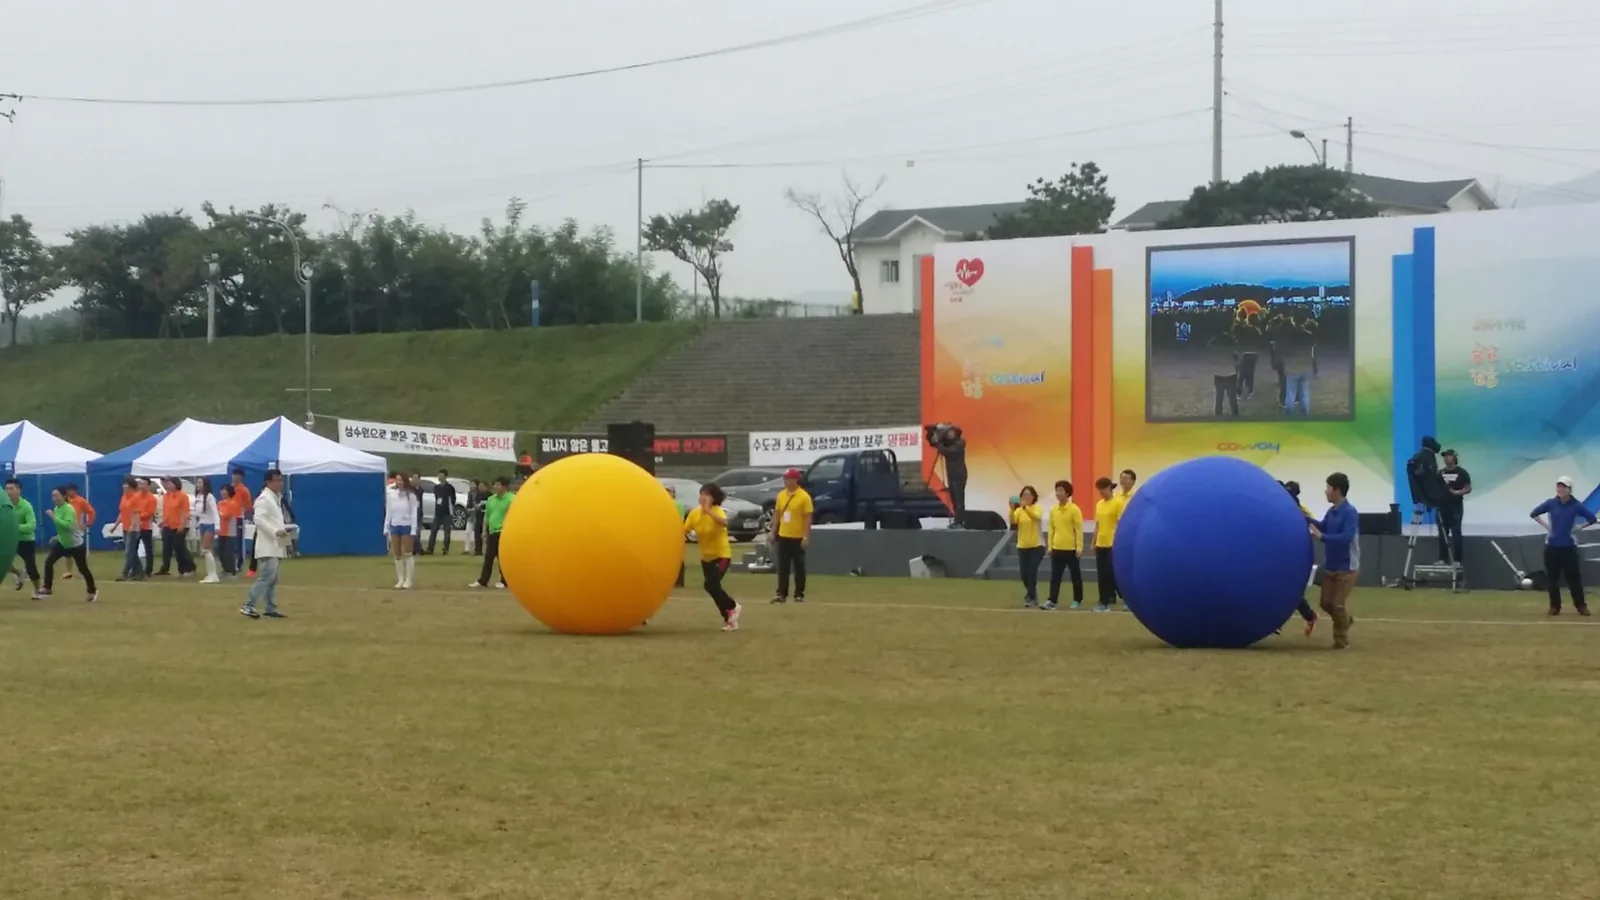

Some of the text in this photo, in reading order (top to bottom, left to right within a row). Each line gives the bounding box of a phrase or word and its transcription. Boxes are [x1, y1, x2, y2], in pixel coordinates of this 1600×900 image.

[344, 424, 387, 440] 상수원으로
[541, 438, 568, 453] 끝나지
[753, 437, 781, 452] 수도권
[785, 436, 804, 451] 최고
[864, 434, 883, 447] 보루
